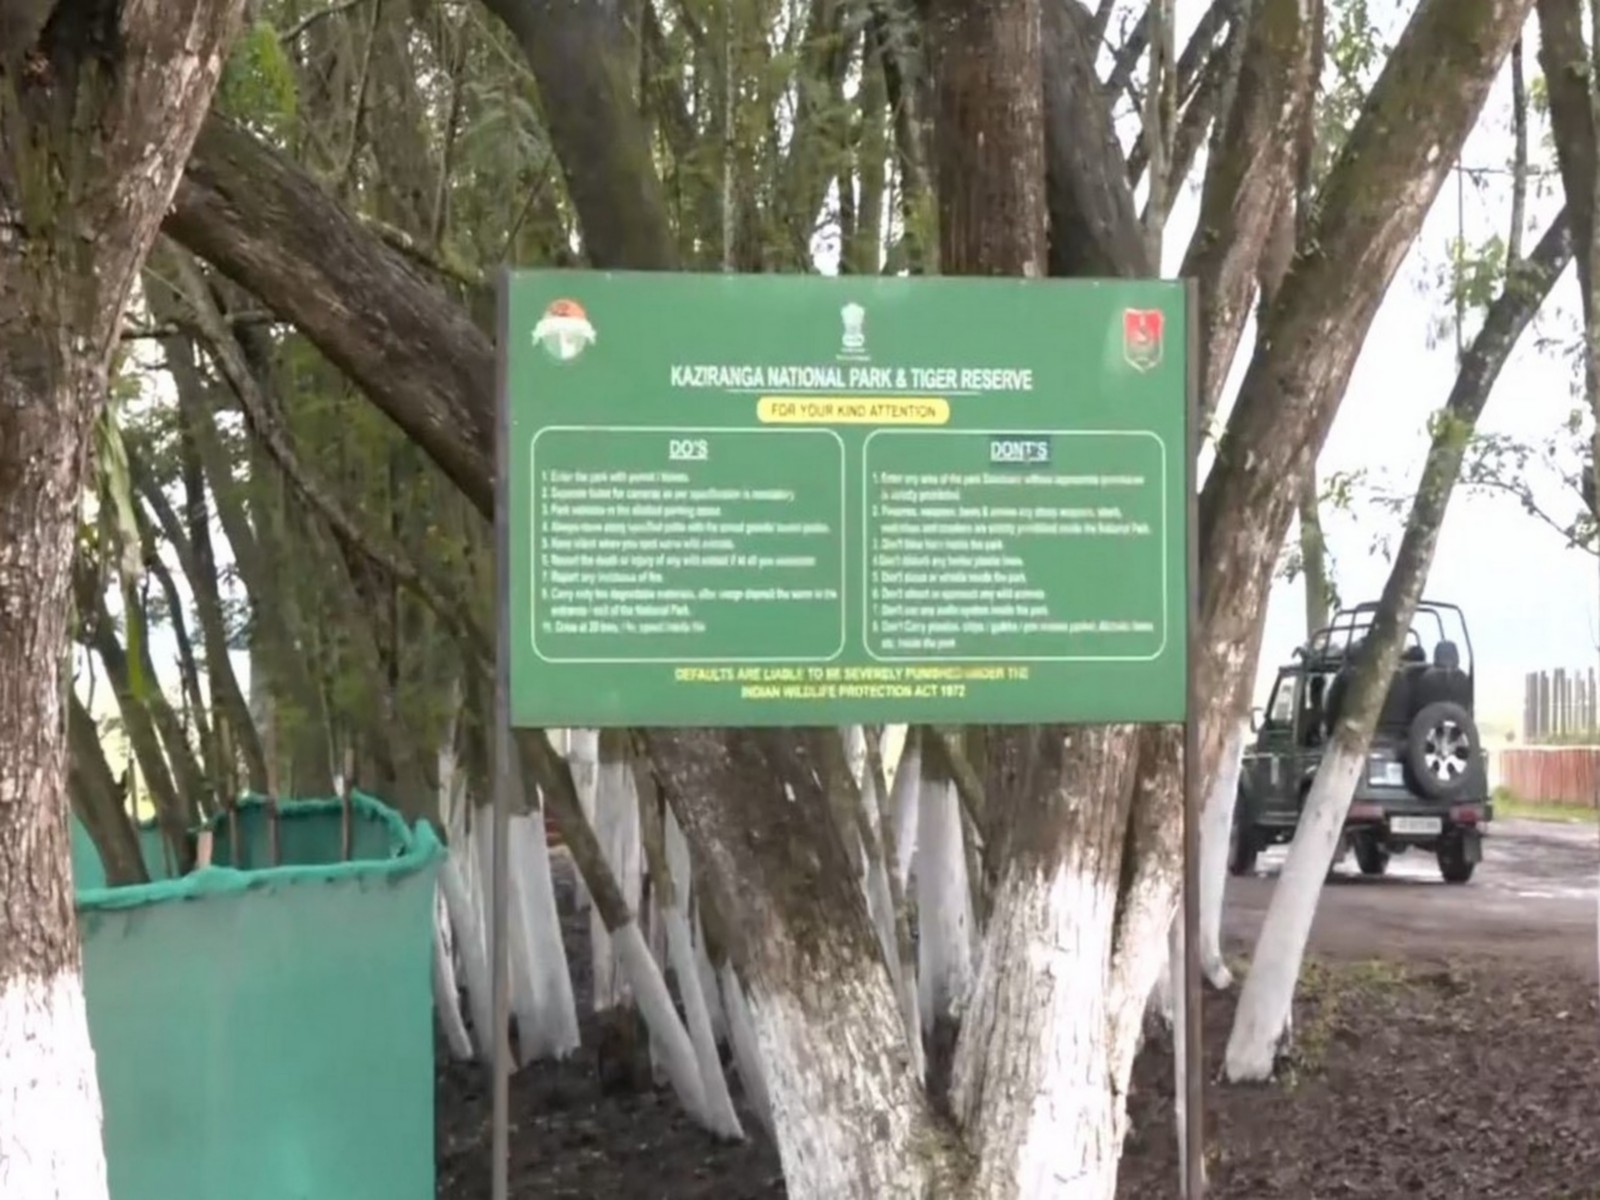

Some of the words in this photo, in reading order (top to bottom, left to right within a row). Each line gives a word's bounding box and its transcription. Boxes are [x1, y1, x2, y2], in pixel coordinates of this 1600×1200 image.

[670, 365, 765, 387] KAZIRANGA
[767, 366, 846, 388] NATIONAL
[850, 366, 892, 388] PARK
[896, 367, 907, 388] &
[911, 368, 958, 389] TIGER
[961, 369, 1034, 390] RESERVE
[771, 403, 796, 417] FOR
[800, 403, 833, 417] YOUR
[837, 403, 866, 417] KIND
[869, 404, 937, 418] ATTENTION
[669, 439, 709, 458] DO'S
[737, 667, 760, 681] ARE
[764, 667, 803, 681] LIABLE
[807, 667, 823, 681] TO
[826, 667, 840, 681] BE
[844, 667, 903, 681] SEVERELY
[1008, 666, 1029, 680] THE
[741, 685, 780, 699] INDIAN
[783, 685, 836, 699] WILDLIFE
[839, 685, 911, 699] PROTECTION
[915, 684, 937, 698] ACT
